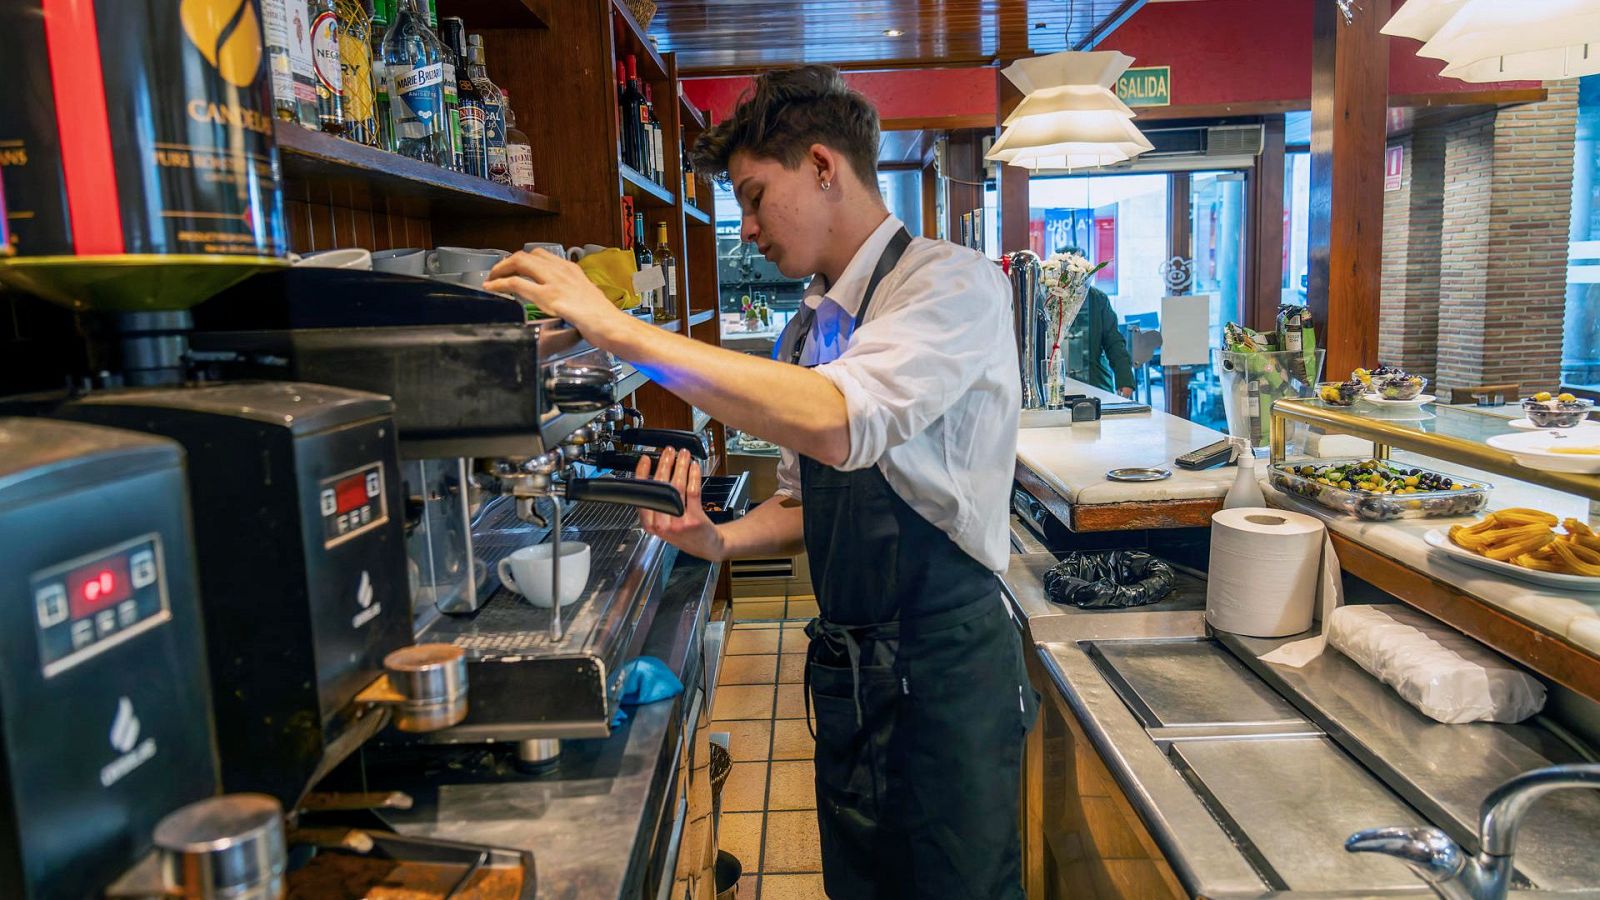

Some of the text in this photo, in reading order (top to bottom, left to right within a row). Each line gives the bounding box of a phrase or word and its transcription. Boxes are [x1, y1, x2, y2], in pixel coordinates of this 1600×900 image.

[397, 75, 419, 89] MARIE
[418, 69, 442, 85] BRIZARD
[1119, 76, 1167, 98] SALIDA
